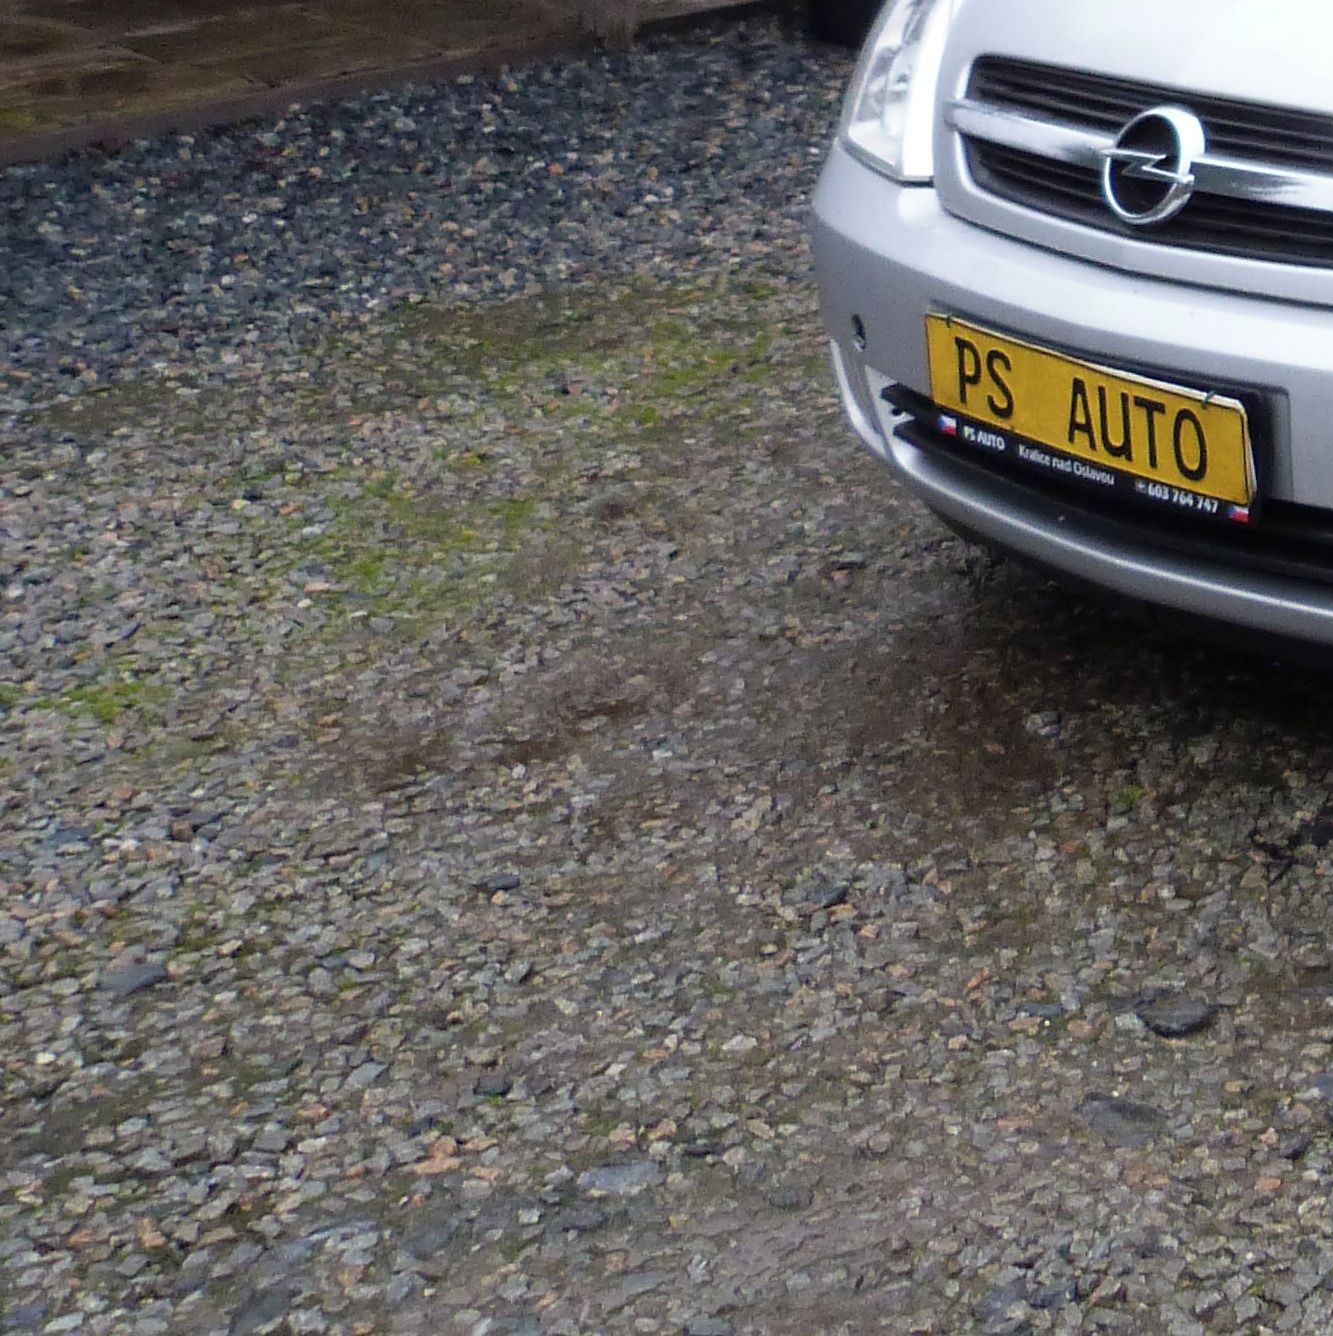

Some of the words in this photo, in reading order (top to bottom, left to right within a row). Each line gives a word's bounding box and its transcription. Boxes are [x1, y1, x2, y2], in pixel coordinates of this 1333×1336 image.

[954, 336, 1015, 420] PS
[1067, 377, 1208, 481] AUTO
[963, 425, 976, 441] PS
[977, 430, 1006, 451] AUTO
[1148, 482, 1169, 500] 603
